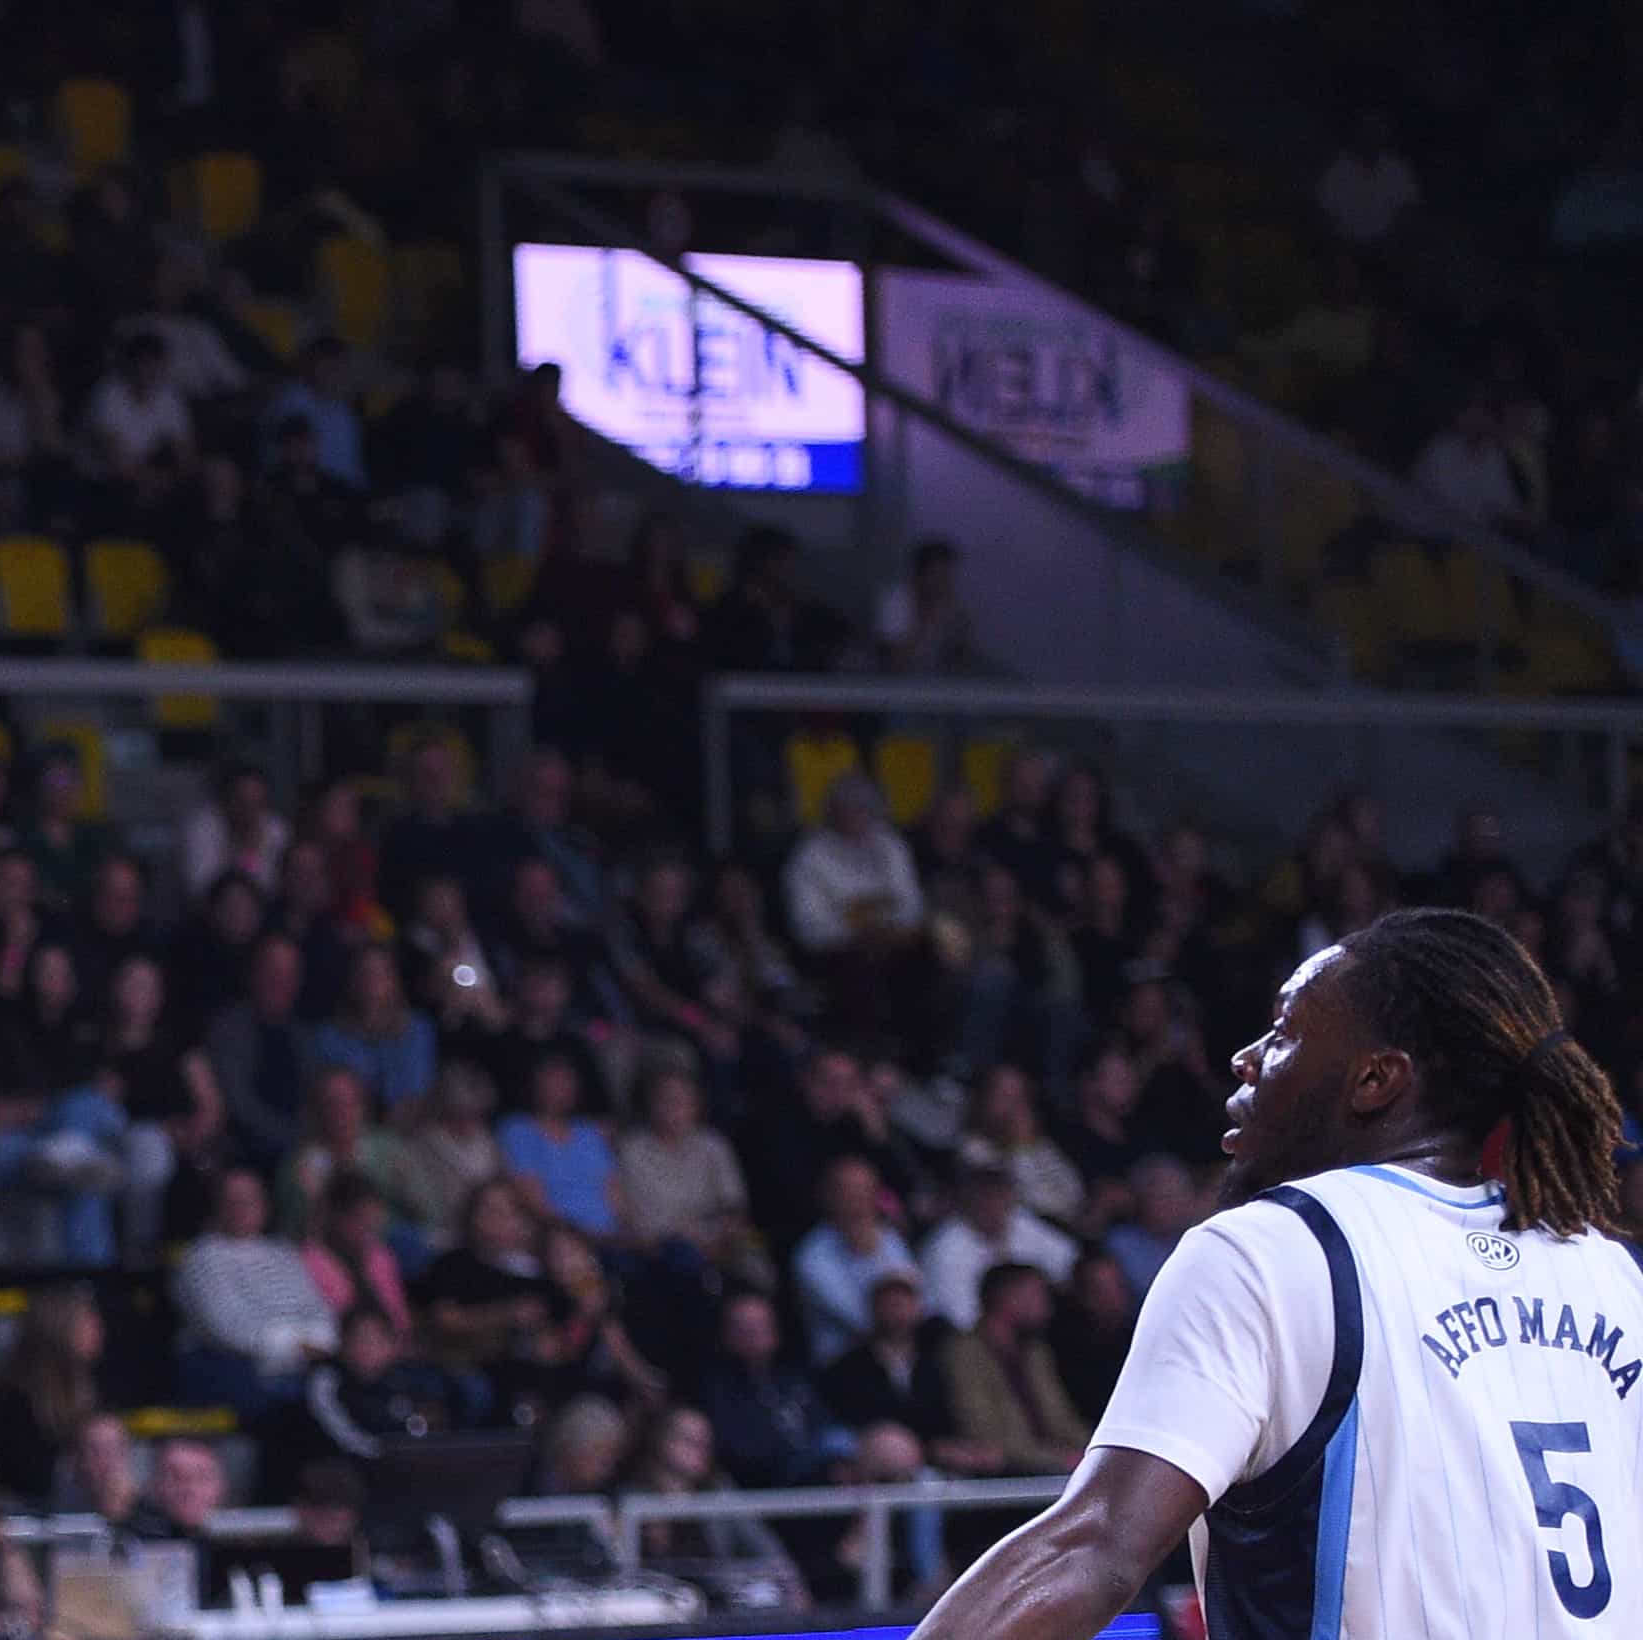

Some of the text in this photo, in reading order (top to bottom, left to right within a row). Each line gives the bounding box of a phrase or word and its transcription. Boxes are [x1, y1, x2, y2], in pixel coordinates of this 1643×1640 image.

[1423, 1296, 1643, 1401] AFFO MAMA
[1510, 1420, 1613, 1620] 5
